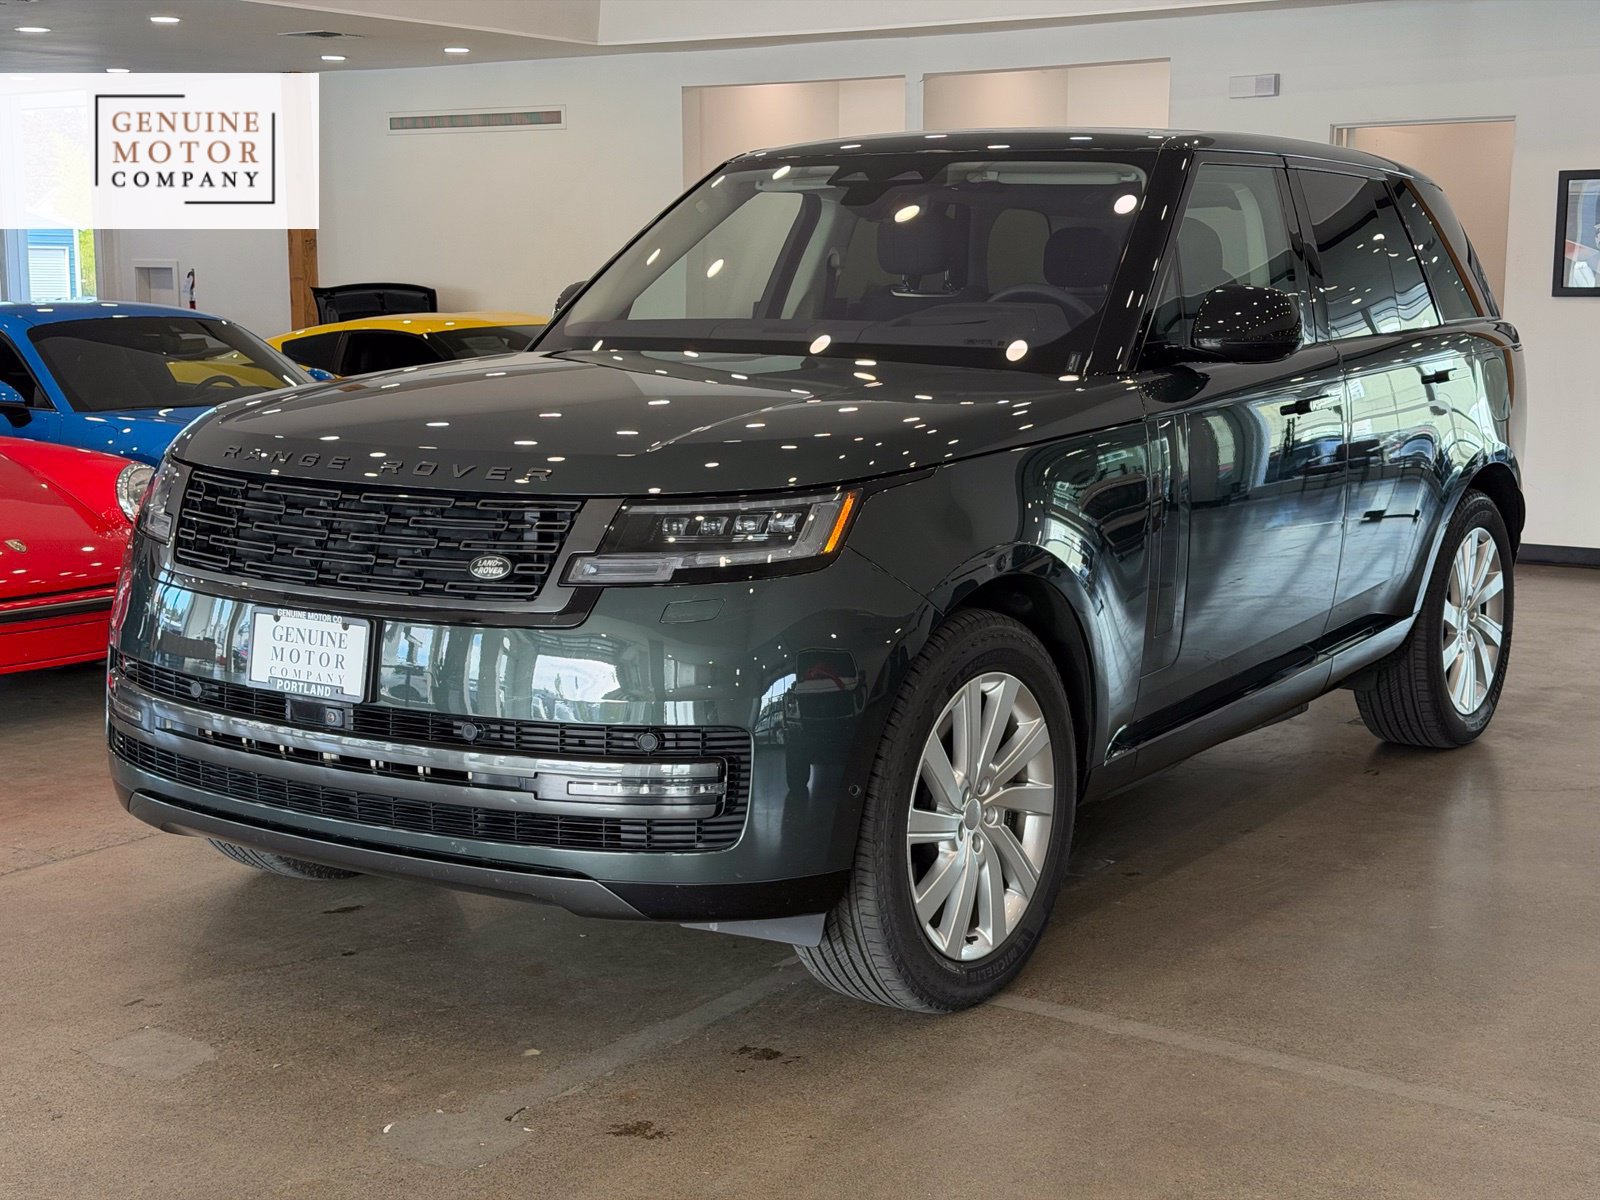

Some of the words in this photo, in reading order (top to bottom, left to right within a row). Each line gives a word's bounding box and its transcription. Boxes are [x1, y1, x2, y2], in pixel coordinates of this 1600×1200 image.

[223, 445, 351, 470] RANGE
[380, 459, 552, 482] ROVER
[477, 566, 504, 574] ROVER
[277, 609, 307, 620] GENUINE
[307, 612, 331, 622] MOTOR
[272, 624, 348, 650] GENUINE
[270, 646, 345, 670] MOTOR
[269, 665, 345, 685] COMPANY
[276, 679, 331, 698] PORTLAND
